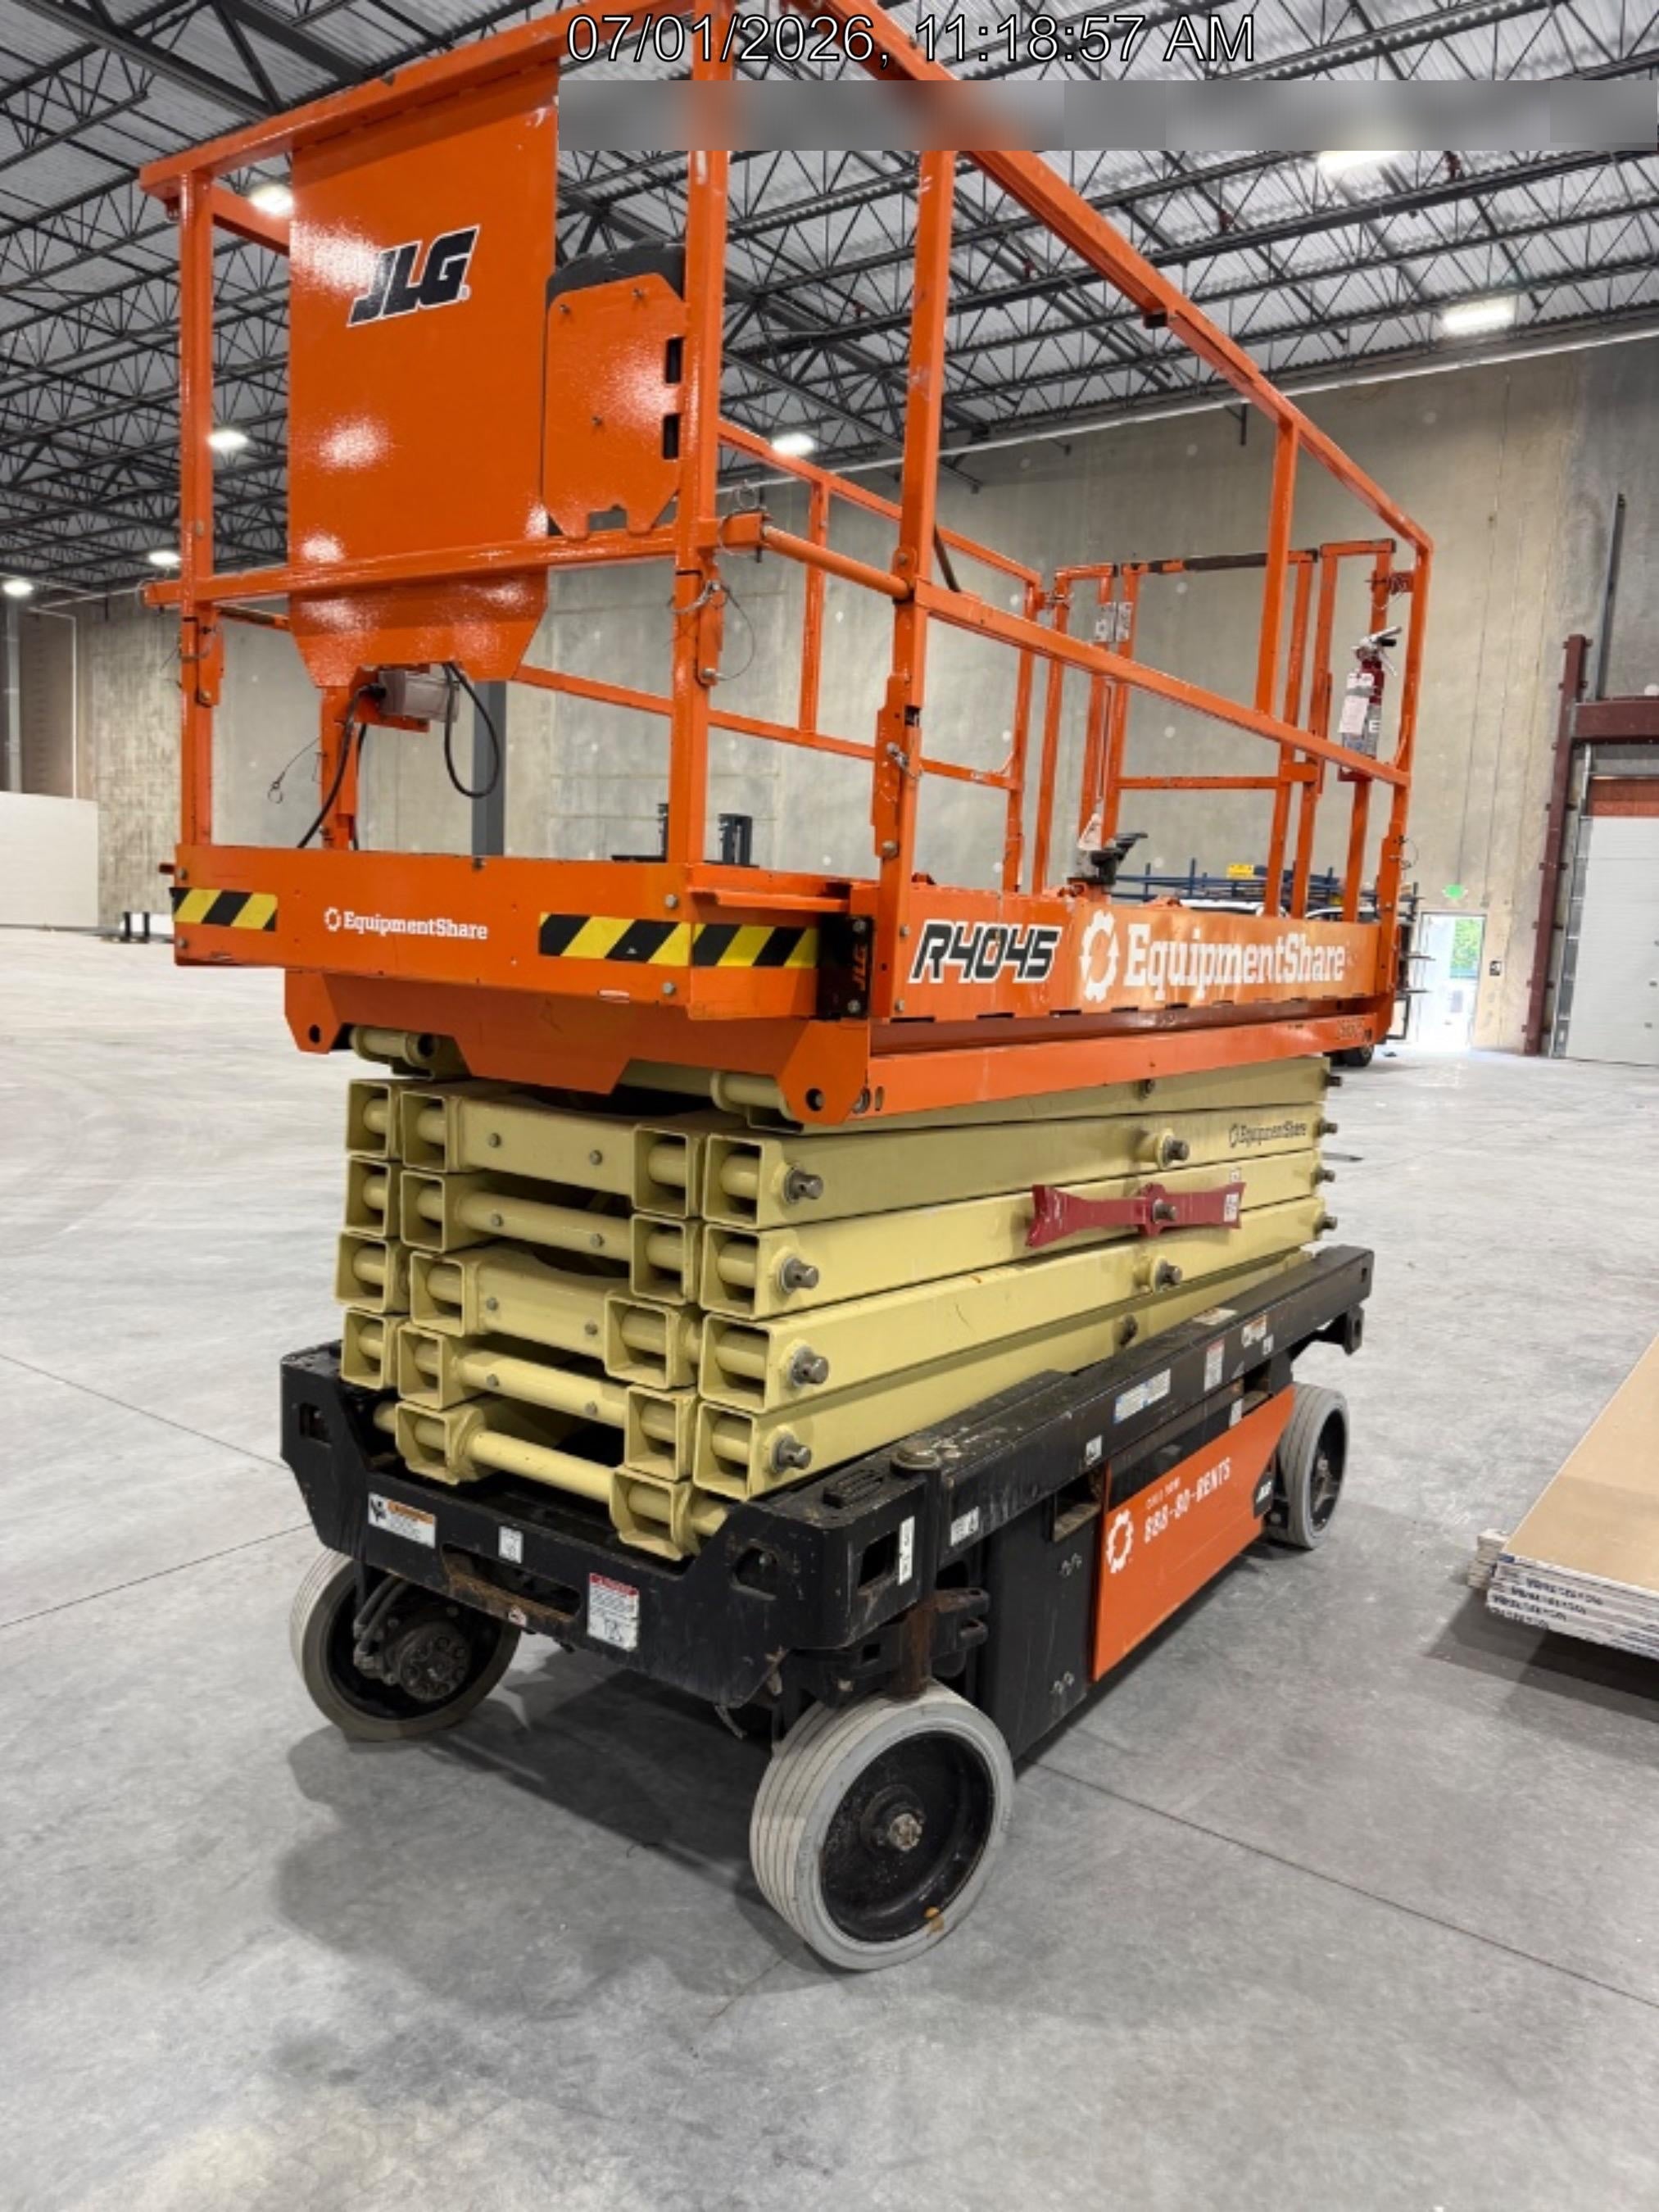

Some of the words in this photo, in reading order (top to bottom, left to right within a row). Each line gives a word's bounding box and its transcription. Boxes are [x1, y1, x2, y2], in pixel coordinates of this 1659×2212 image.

[347, 224, 481, 329] JLG
[343, 910, 488, 941] EquipmentShare
[908, 918, 1063, 984] R4045
[1122, 922, 1347, 1002] EquipmentShare
